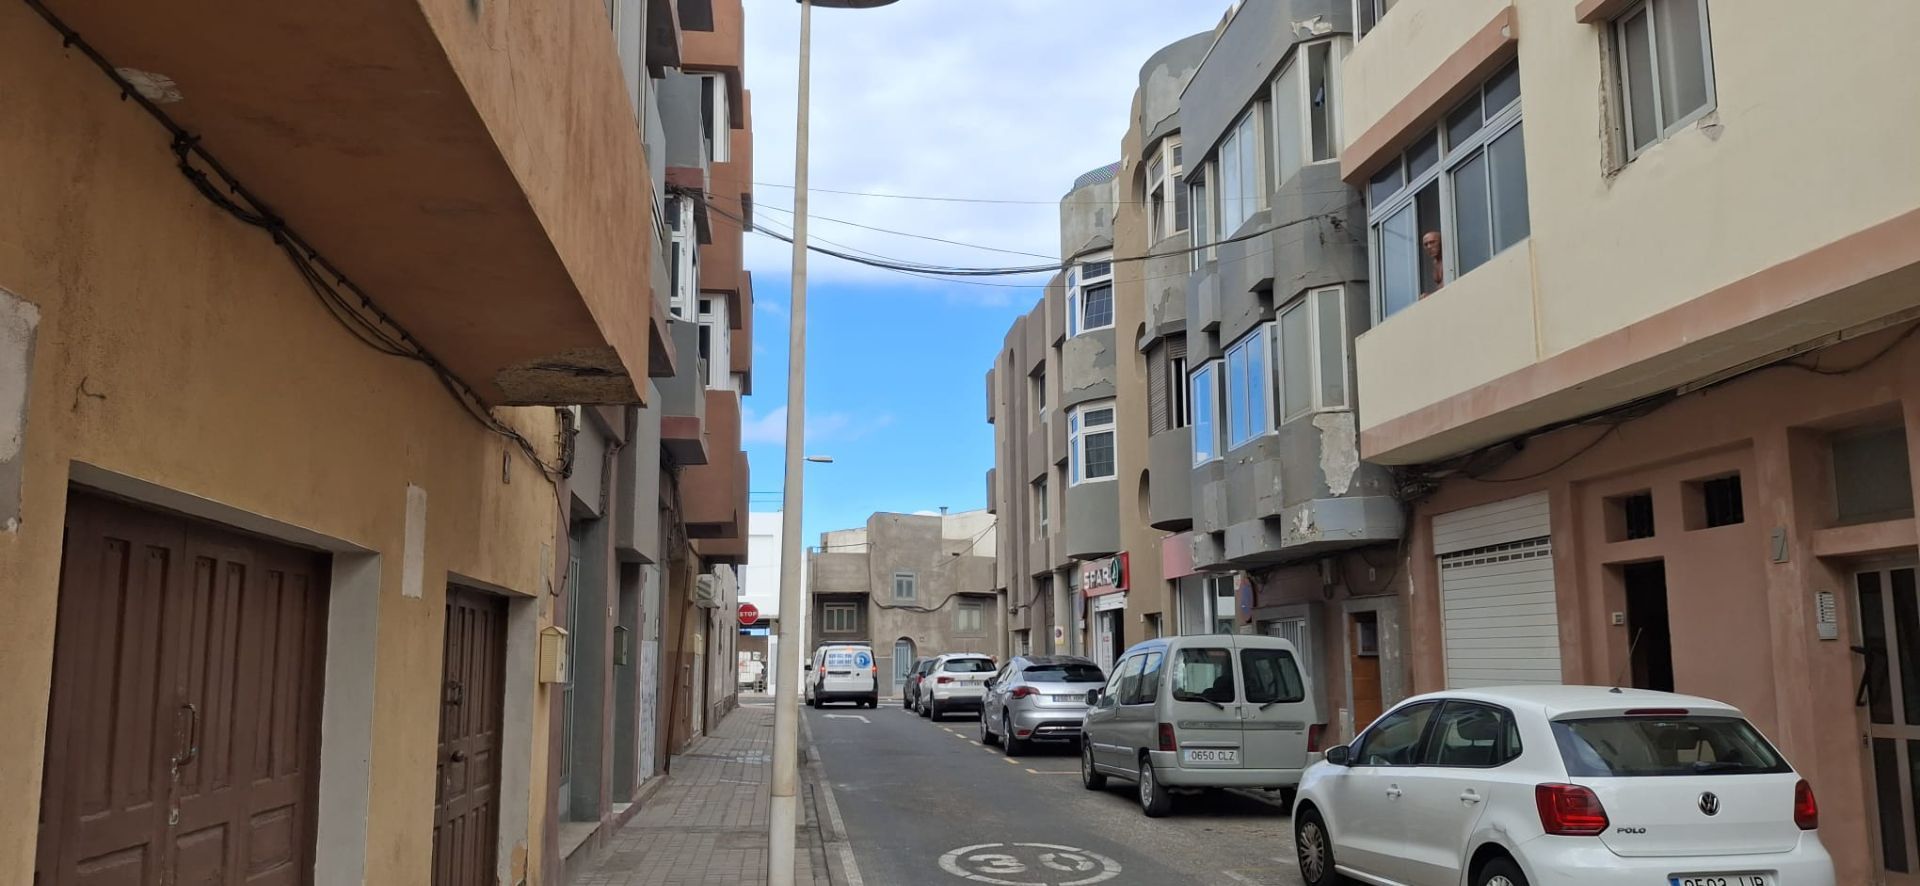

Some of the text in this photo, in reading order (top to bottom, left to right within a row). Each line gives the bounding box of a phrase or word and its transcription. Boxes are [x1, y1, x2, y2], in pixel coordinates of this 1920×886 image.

[1083, 567, 1111, 590] SPAR
[1191, 751, 1235, 761] 0650 CLZ
[968, 853, 1095, 873] 30
